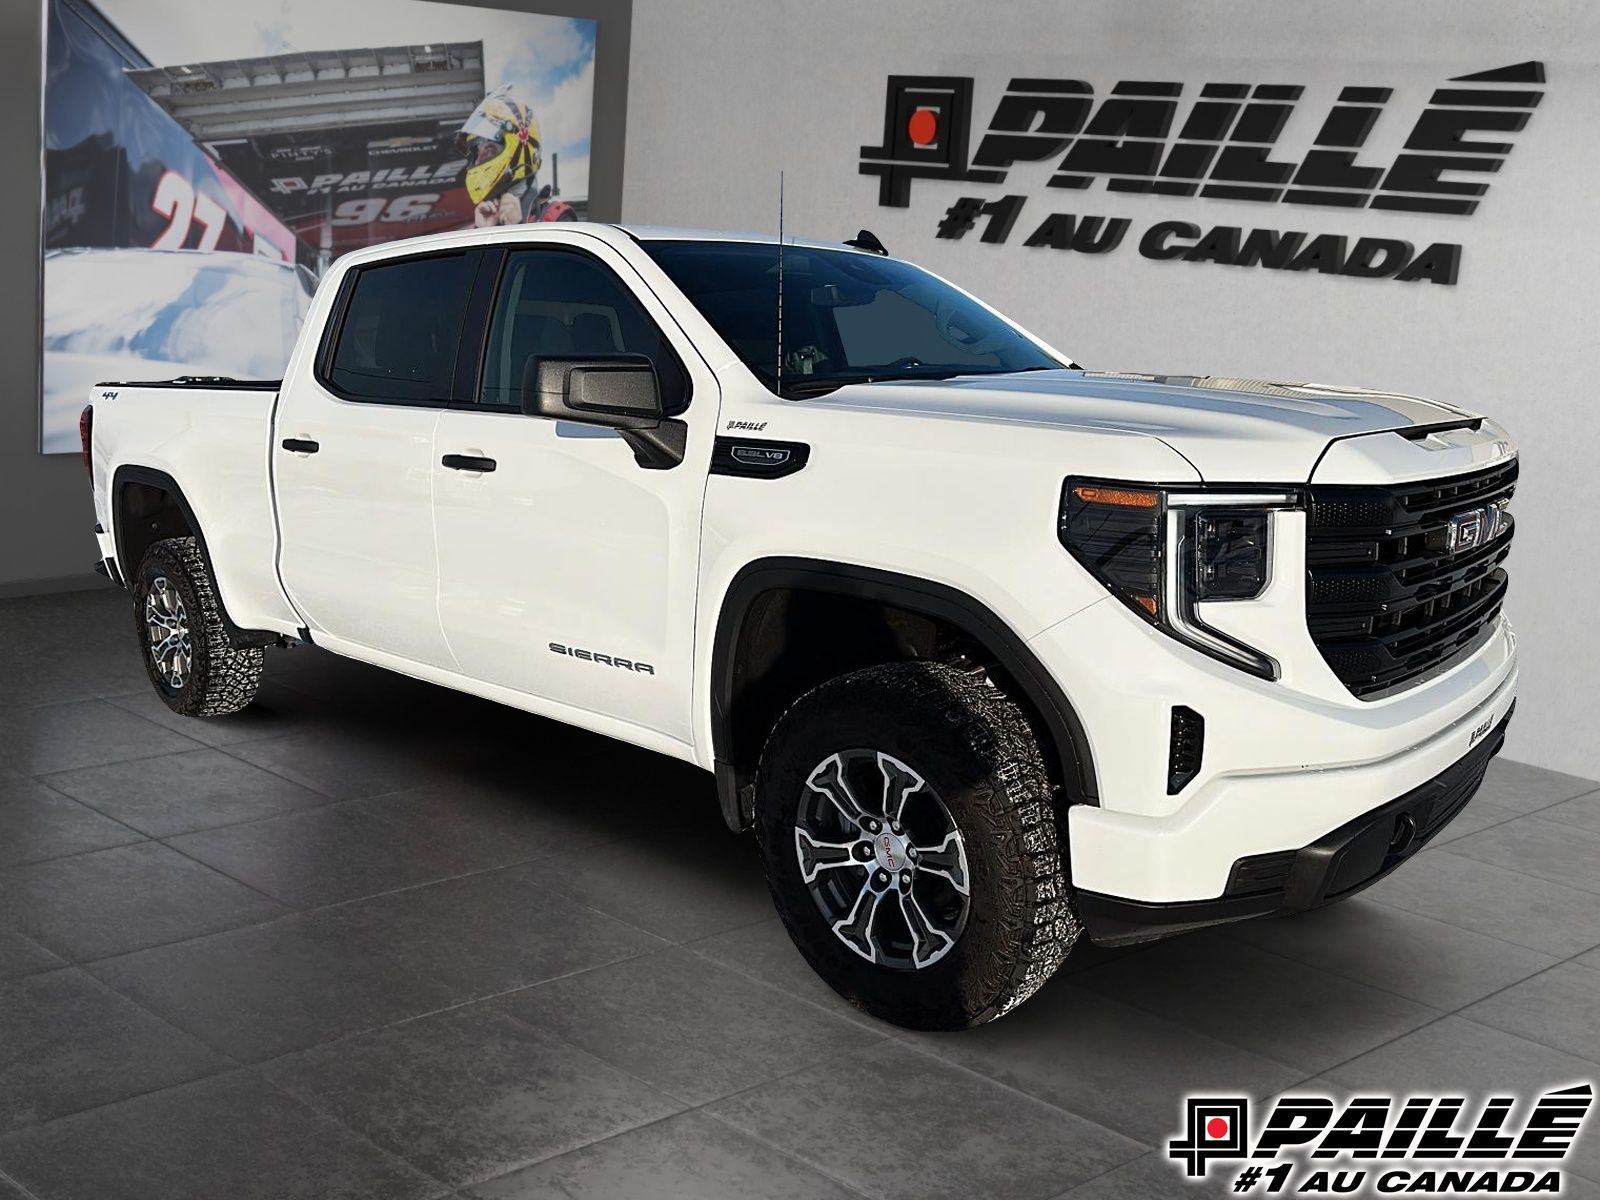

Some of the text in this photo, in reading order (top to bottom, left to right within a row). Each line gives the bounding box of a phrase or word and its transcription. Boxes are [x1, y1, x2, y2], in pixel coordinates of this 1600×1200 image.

[368, 145, 438, 155] CHEVROLET
[966, 61, 1546, 215] PAILLÉ
[337, 184, 366, 193] AU
[372, 177, 456, 190] CANADA
[150, 170, 227, 250] 27
[331, 193, 441, 226] 96
[936, 194, 1462, 285] #1 AU CANADA
[548, 642, 655, 675] SIERRA
[884, 836, 895, 868] GMC
